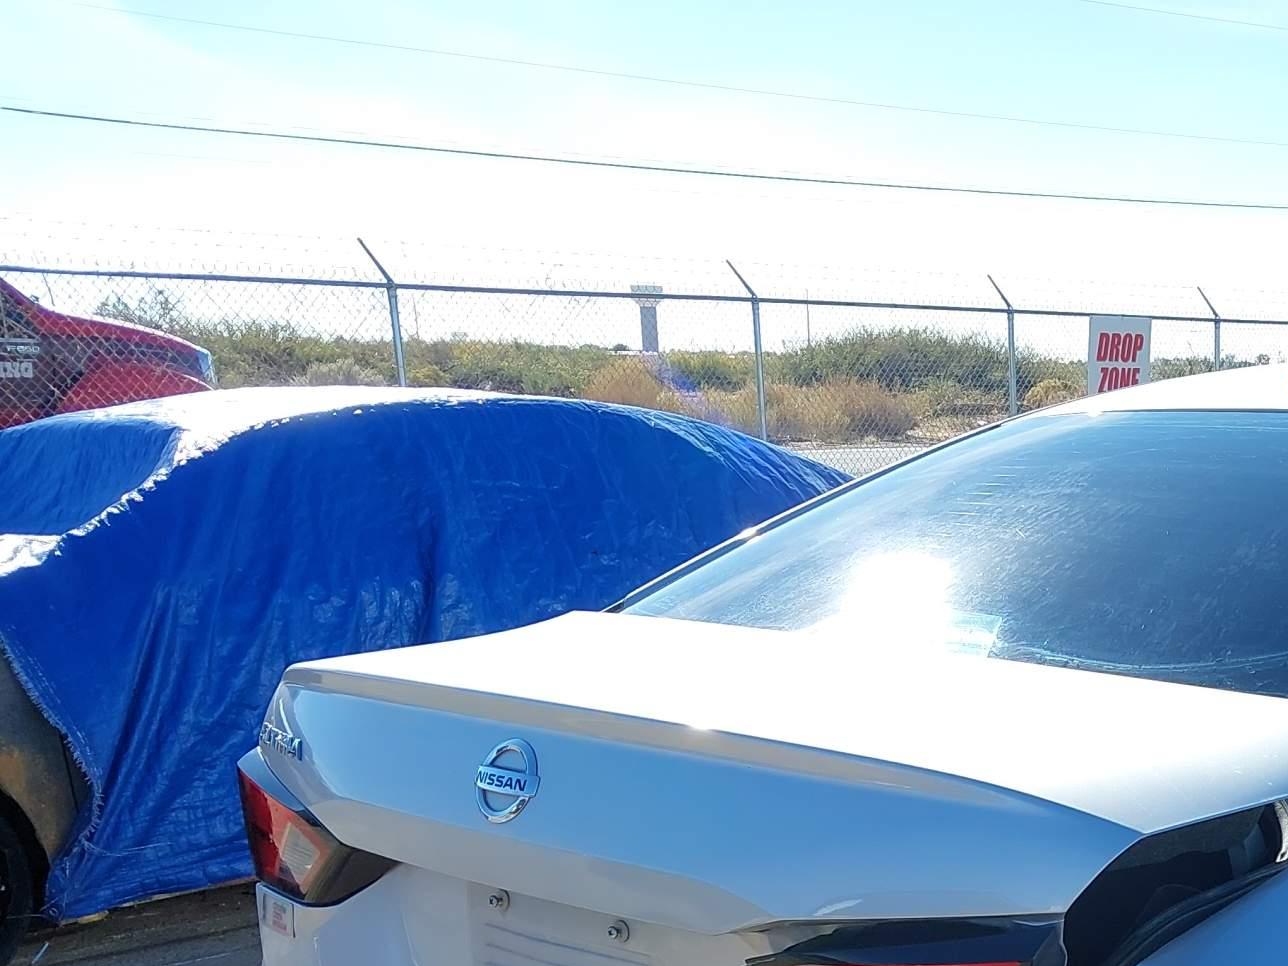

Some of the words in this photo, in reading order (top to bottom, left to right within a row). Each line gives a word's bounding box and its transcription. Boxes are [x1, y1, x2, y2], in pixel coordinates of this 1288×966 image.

[1096, 331, 1145, 363] DROP
[1097, 366, 1141, 393] ZONE
[475, 769, 528, 792] NISSAN
